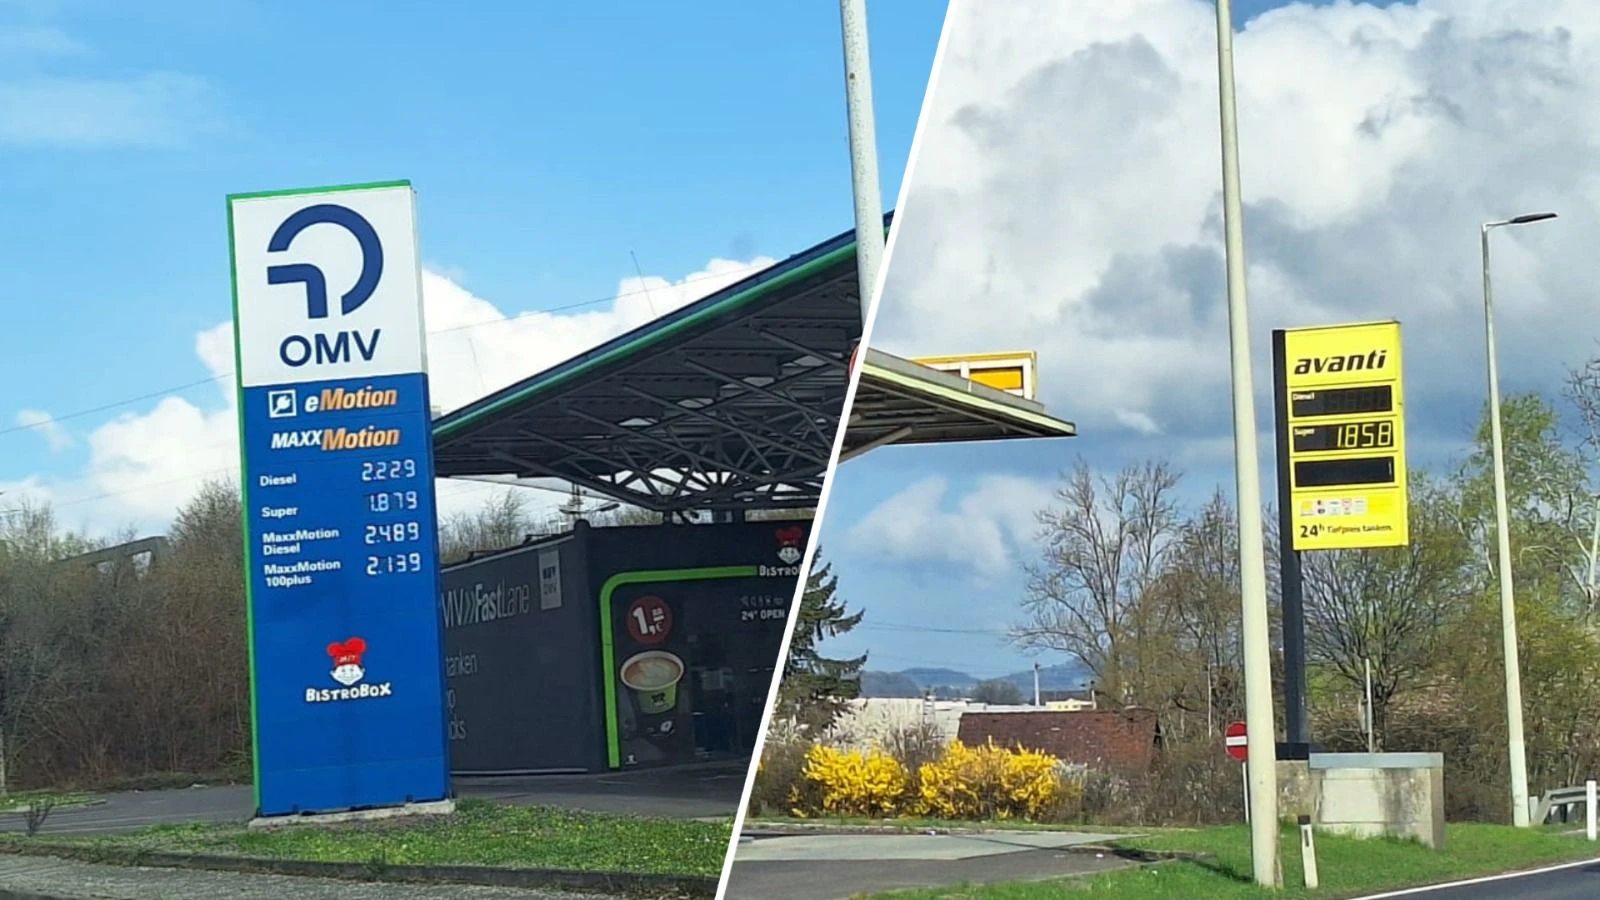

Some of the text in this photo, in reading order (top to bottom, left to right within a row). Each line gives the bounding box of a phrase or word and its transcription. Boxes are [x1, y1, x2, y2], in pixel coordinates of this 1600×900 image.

[279, 328, 381, 367] OMV
[1294, 350, 1387, 375] avanti
[304, 385, 398, 412] eMotion
[271, 426, 400, 451] MAXXMotion
[259, 459, 415, 486] Diesel 2.229
[261, 491, 417, 518] Super 1.879
[262, 522, 419, 544] MaxxMotion 2.489
[263, 543, 300, 556] Diesel
[264, 552, 421, 575] MaxxMotion 2.139
[266, 574, 312, 588] 100plus
